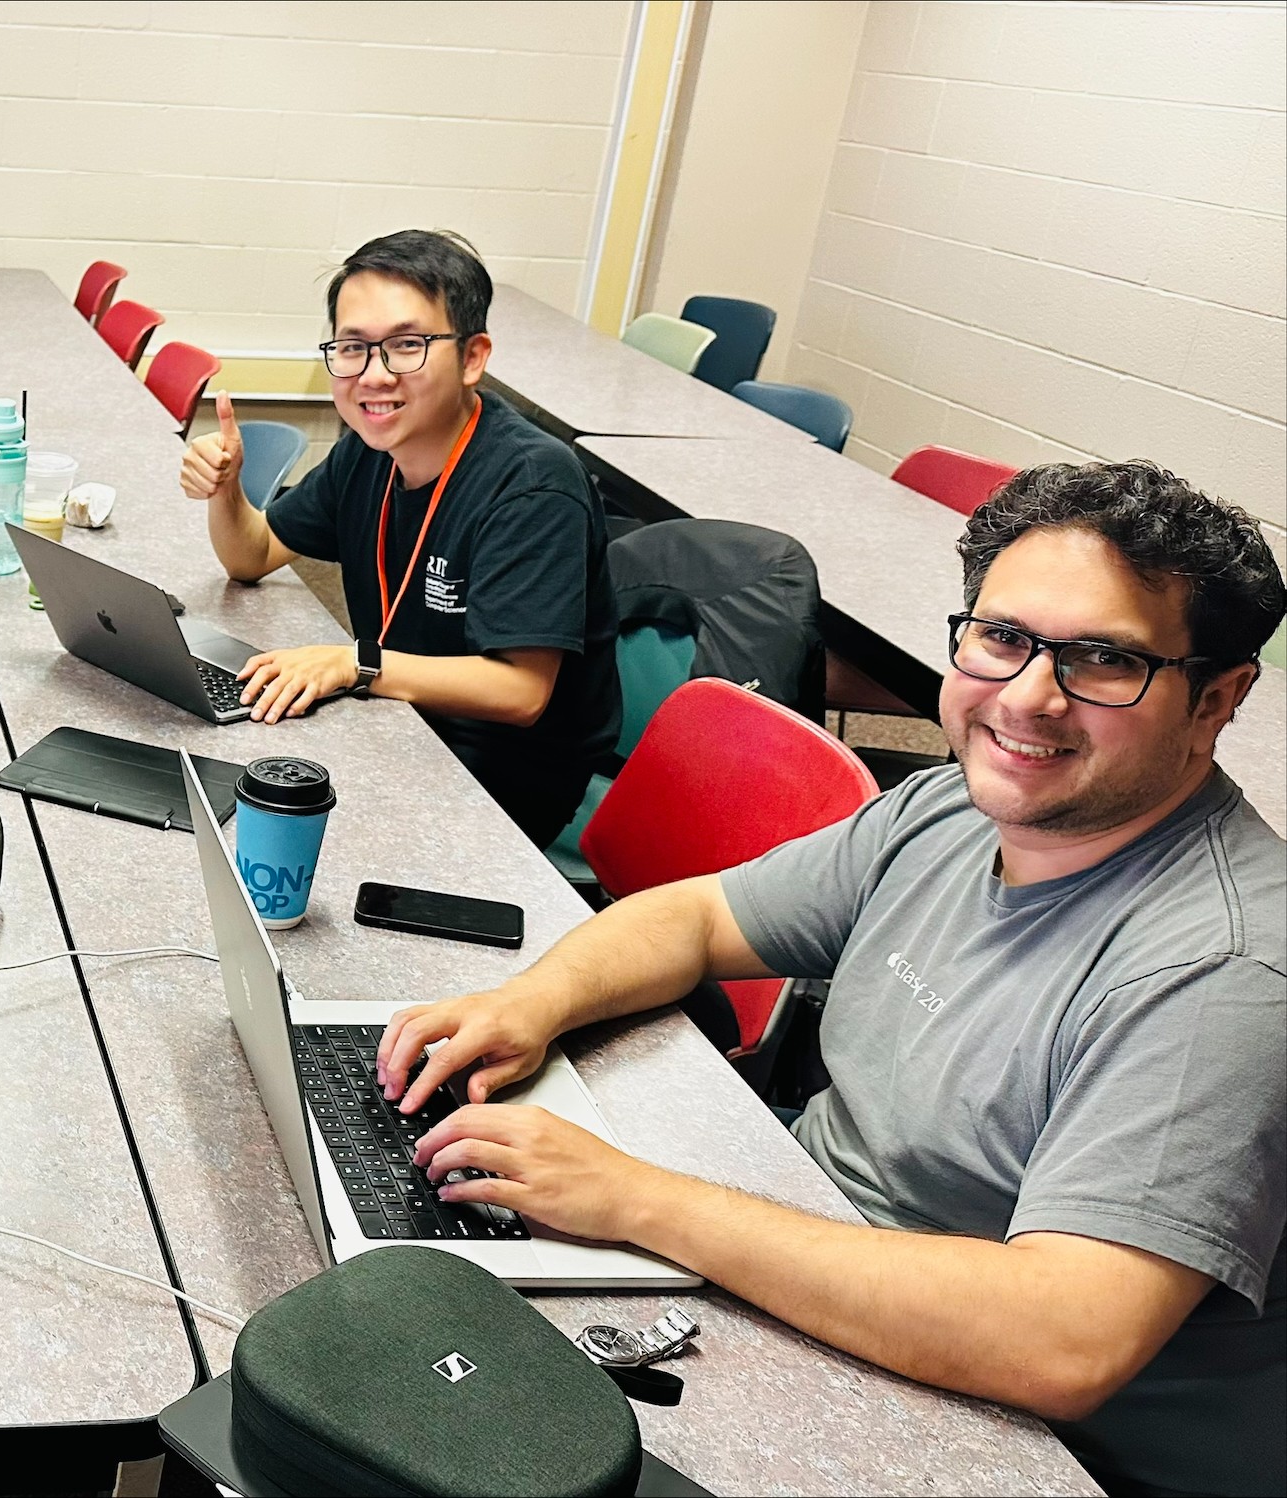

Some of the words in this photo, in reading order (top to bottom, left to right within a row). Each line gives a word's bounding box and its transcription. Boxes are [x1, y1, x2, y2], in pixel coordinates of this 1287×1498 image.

[426, 555, 449, 578] RIT
[236, 850, 314, 894] NON-
[917, 990, 947, 1014] 20
